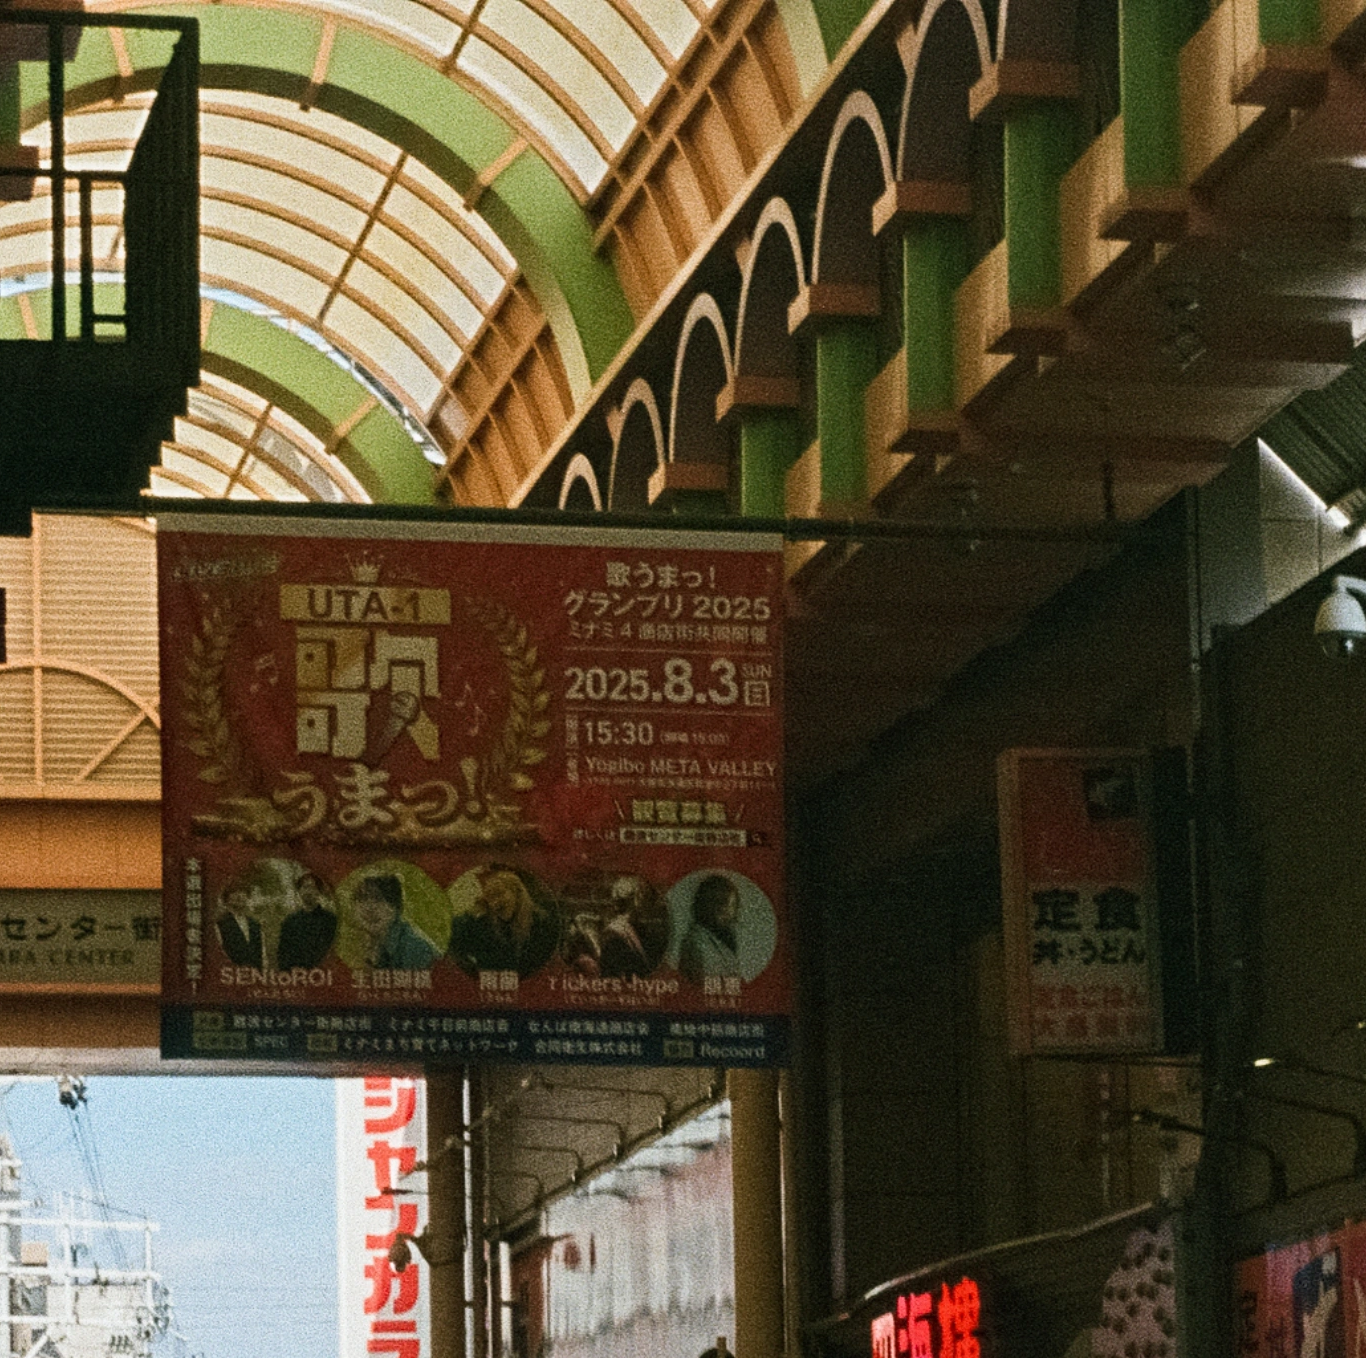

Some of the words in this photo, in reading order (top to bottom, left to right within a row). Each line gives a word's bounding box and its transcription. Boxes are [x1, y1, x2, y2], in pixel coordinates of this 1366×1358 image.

[307, 587, 422, 621] UTA-1
[565, 589, 683, 619] グランプリ
[693, 597, 771, 621] 2025
[565, 658, 738, 704] 2025.8.3
[741, 665, 773, 679] SUN
[586, 721, 654, 746] 15:30
[586, 756, 645, 775] Yogibo
[650, 759, 702, 776] META
[707, 761, 779, 778] VALLEY
[220, 965, 333, 987] SENtoROI
